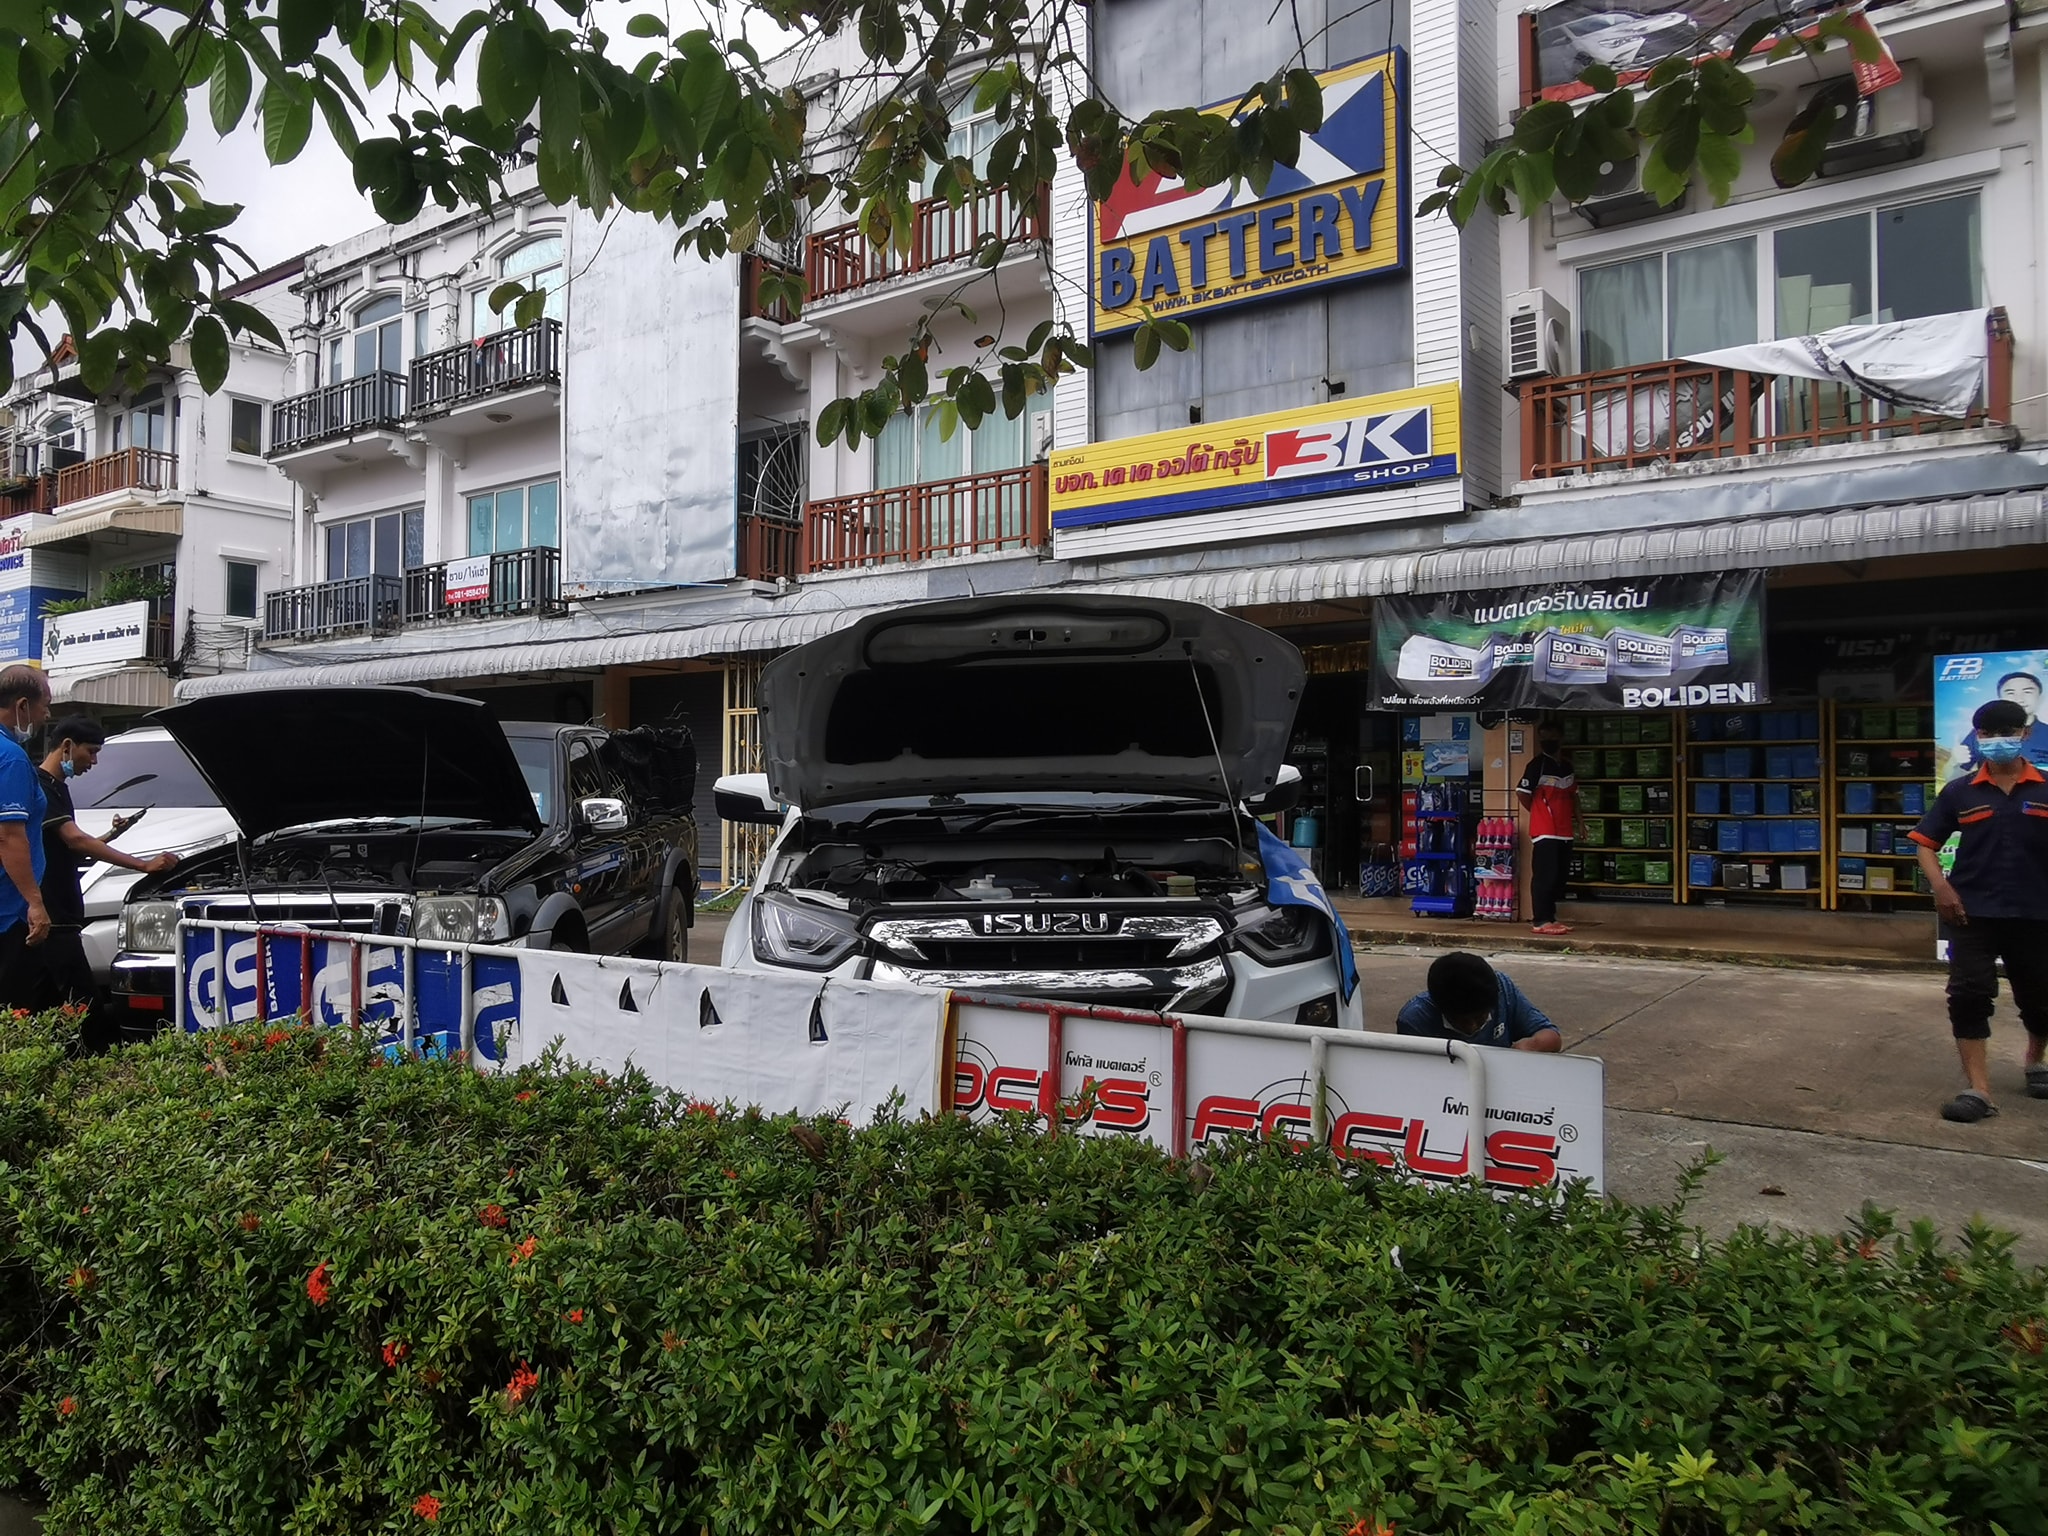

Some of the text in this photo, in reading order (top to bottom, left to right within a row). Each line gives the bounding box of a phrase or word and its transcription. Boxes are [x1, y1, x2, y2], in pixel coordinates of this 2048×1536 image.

[1101, 179, 1386, 311] BATTERY
[1280, 406, 1420, 474] 3K
[1055, 438, 1261, 494] บจก. เค เค ออโต้ กรุ๊ป
[1353, 461, 1433, 483] SHOP
[1474, 586, 1649, 624] แบตเตอรี่โบลิเด้น
[1552, 640, 1605, 658] BOLIDEN
[1618, 638, 1670, 655] BOLIDEN
[1683, 634, 1725, 645] BOLIDEN
[1430, 655, 1472, 669] BOLIDEN
[1942, 657, 1984, 675] FB
[1939, 673, 1981, 682] BATTERY
[1623, 682, 1751, 708] BOLIDEN
[983, 913, 1109, 934] ISUZU
[1065, 1050, 1147, 1074] โฟกัส แบตเตอรี่
[1191, 1094, 1561, 1193] FOCUS
